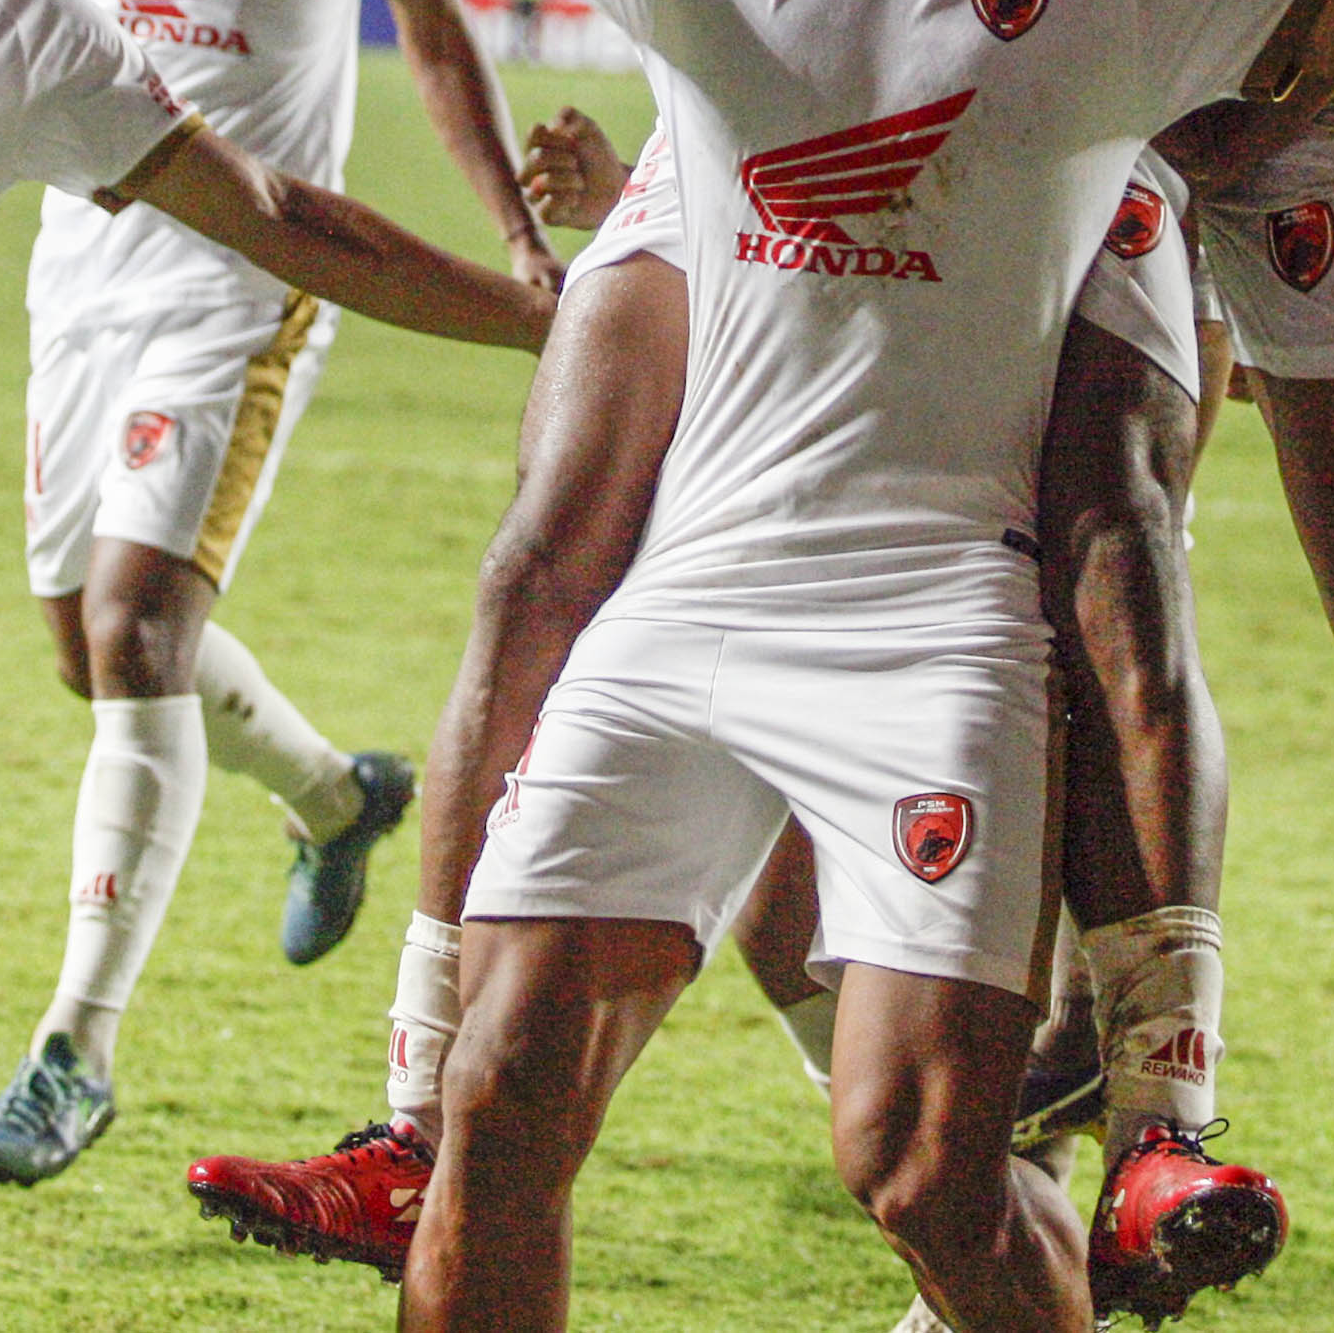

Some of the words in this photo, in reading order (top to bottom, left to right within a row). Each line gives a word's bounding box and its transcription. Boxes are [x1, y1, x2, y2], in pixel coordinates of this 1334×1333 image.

[119, 15, 251, 55] ONDA
[734, 231, 943, 283] HONDA
[1140, 1060, 1205, 1086] REWAKO
